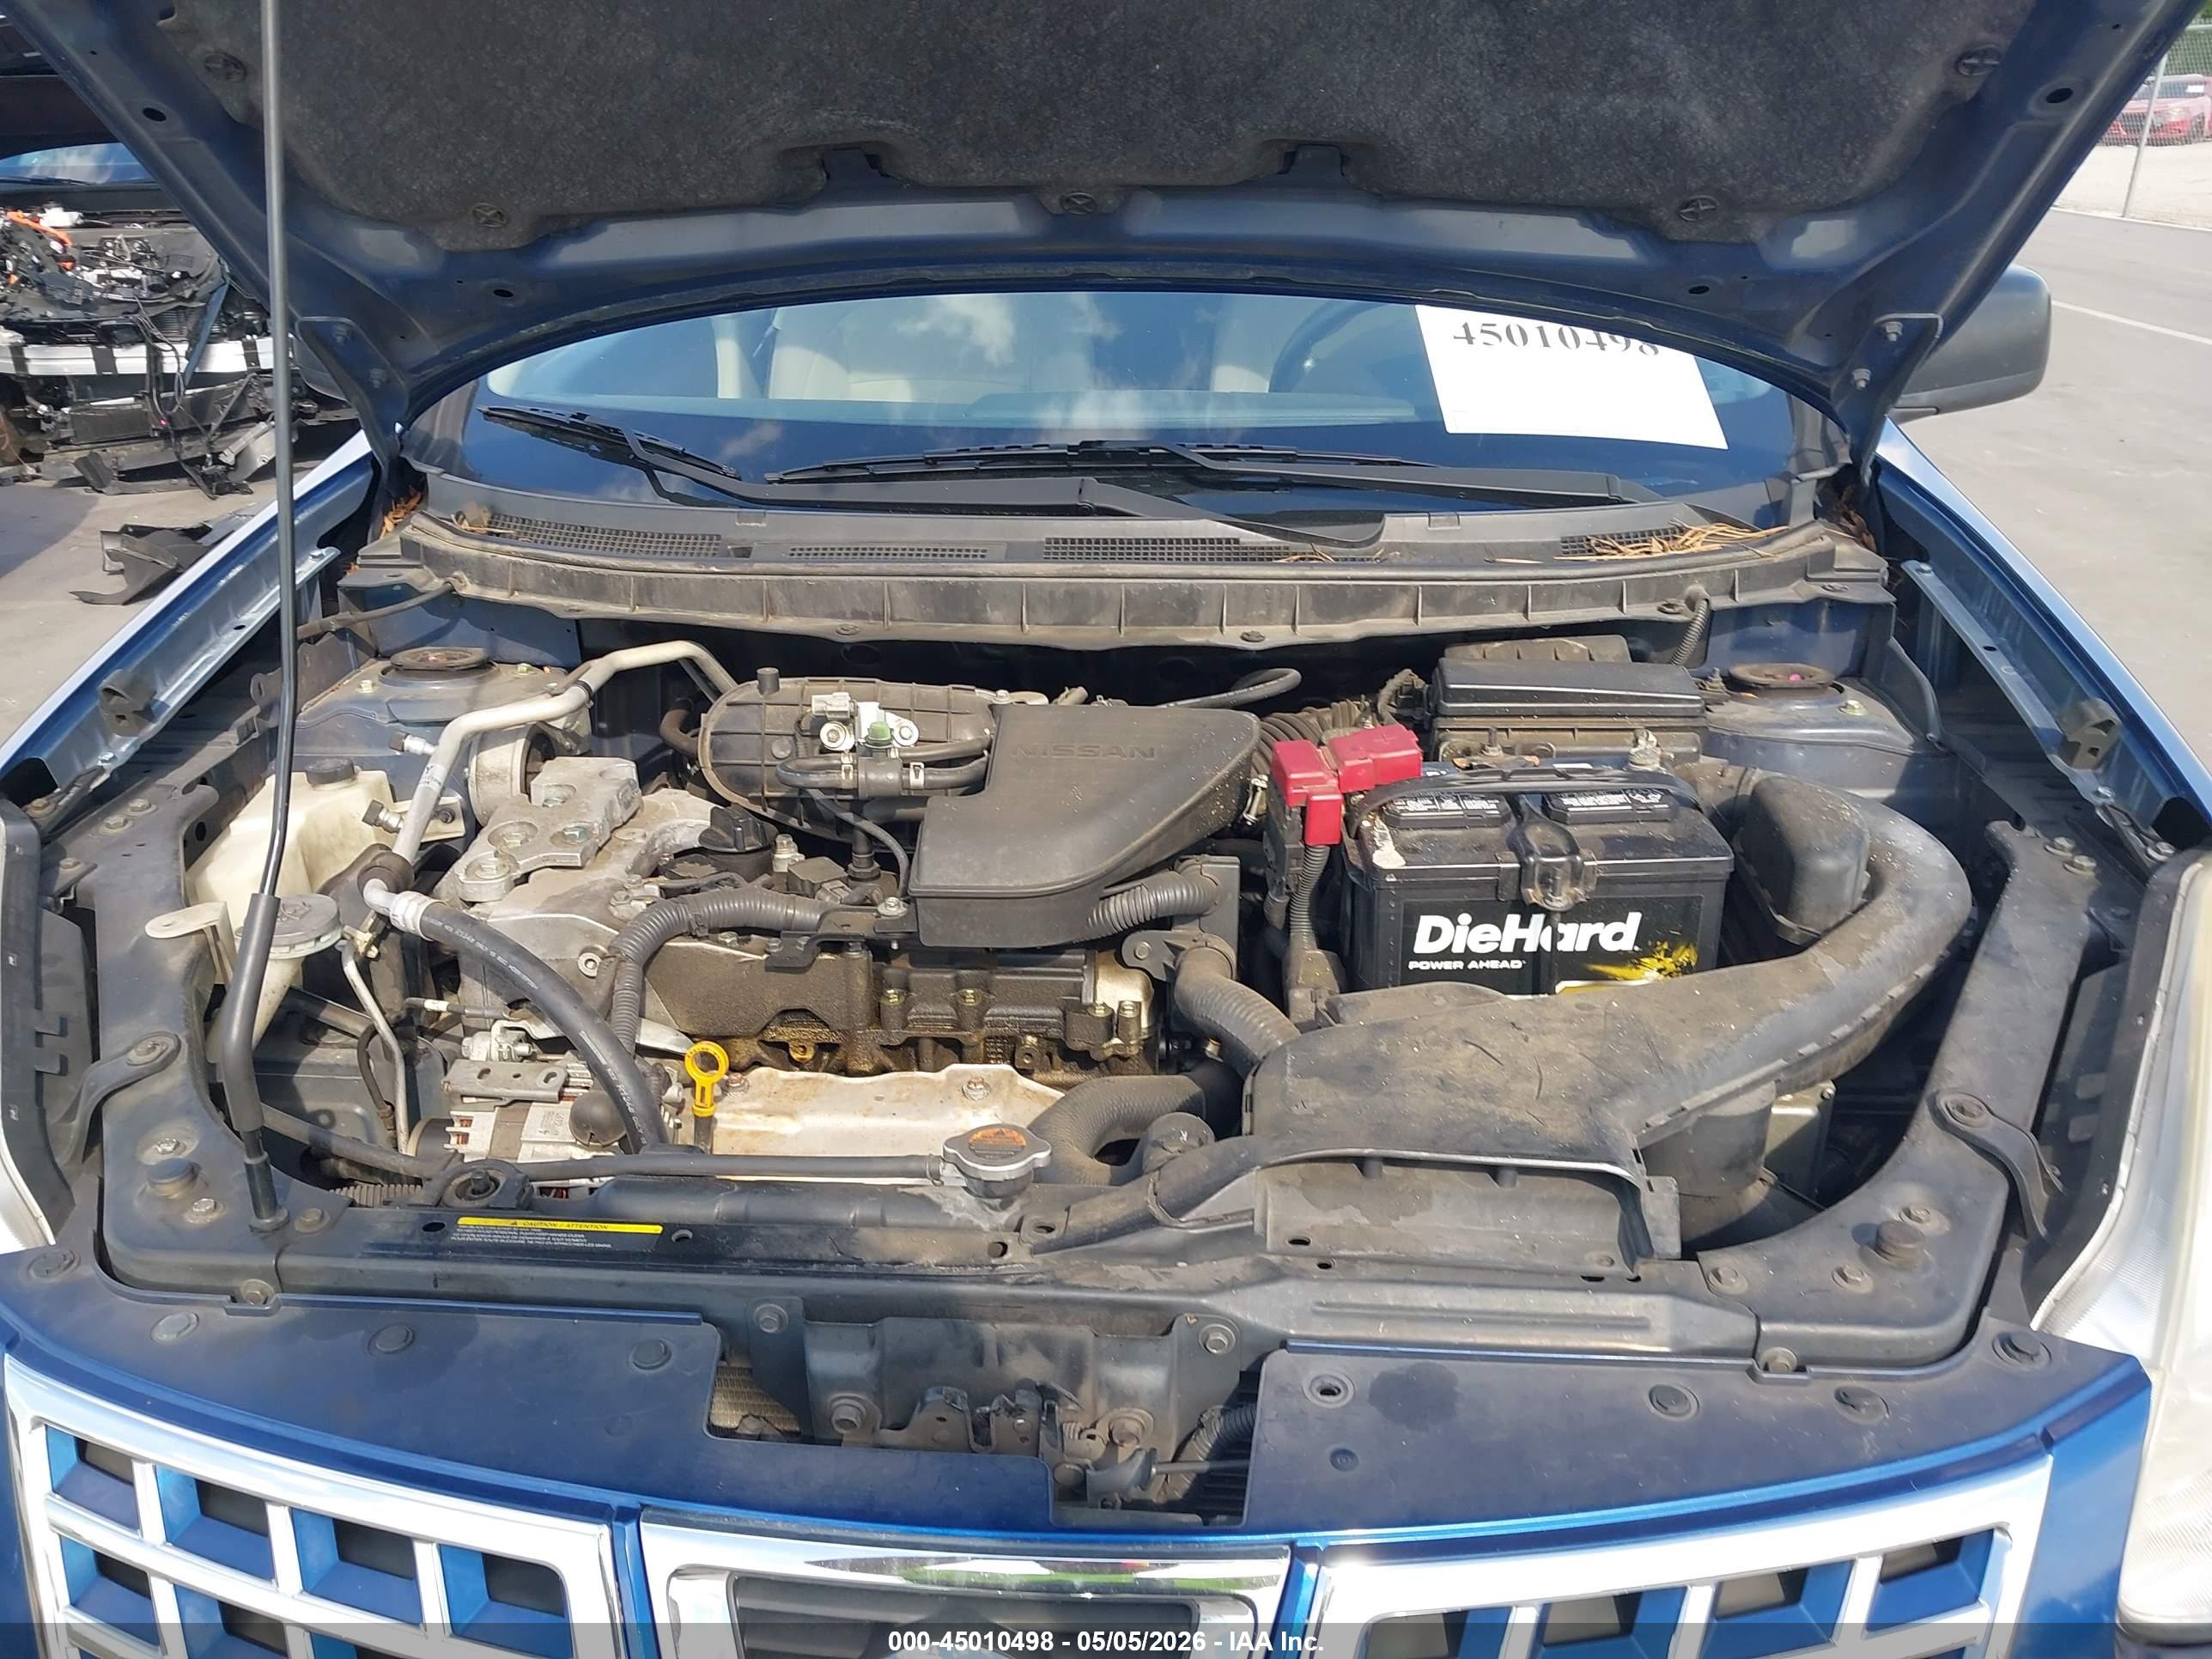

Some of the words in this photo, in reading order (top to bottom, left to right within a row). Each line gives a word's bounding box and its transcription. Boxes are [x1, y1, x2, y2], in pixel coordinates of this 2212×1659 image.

[1012, 744, 1155, 760] NISSAN
[1413, 912, 1642, 953] DieHard
[1408, 960, 1464, 970] POWER
[1468, 959, 1523, 969] AHEAD
